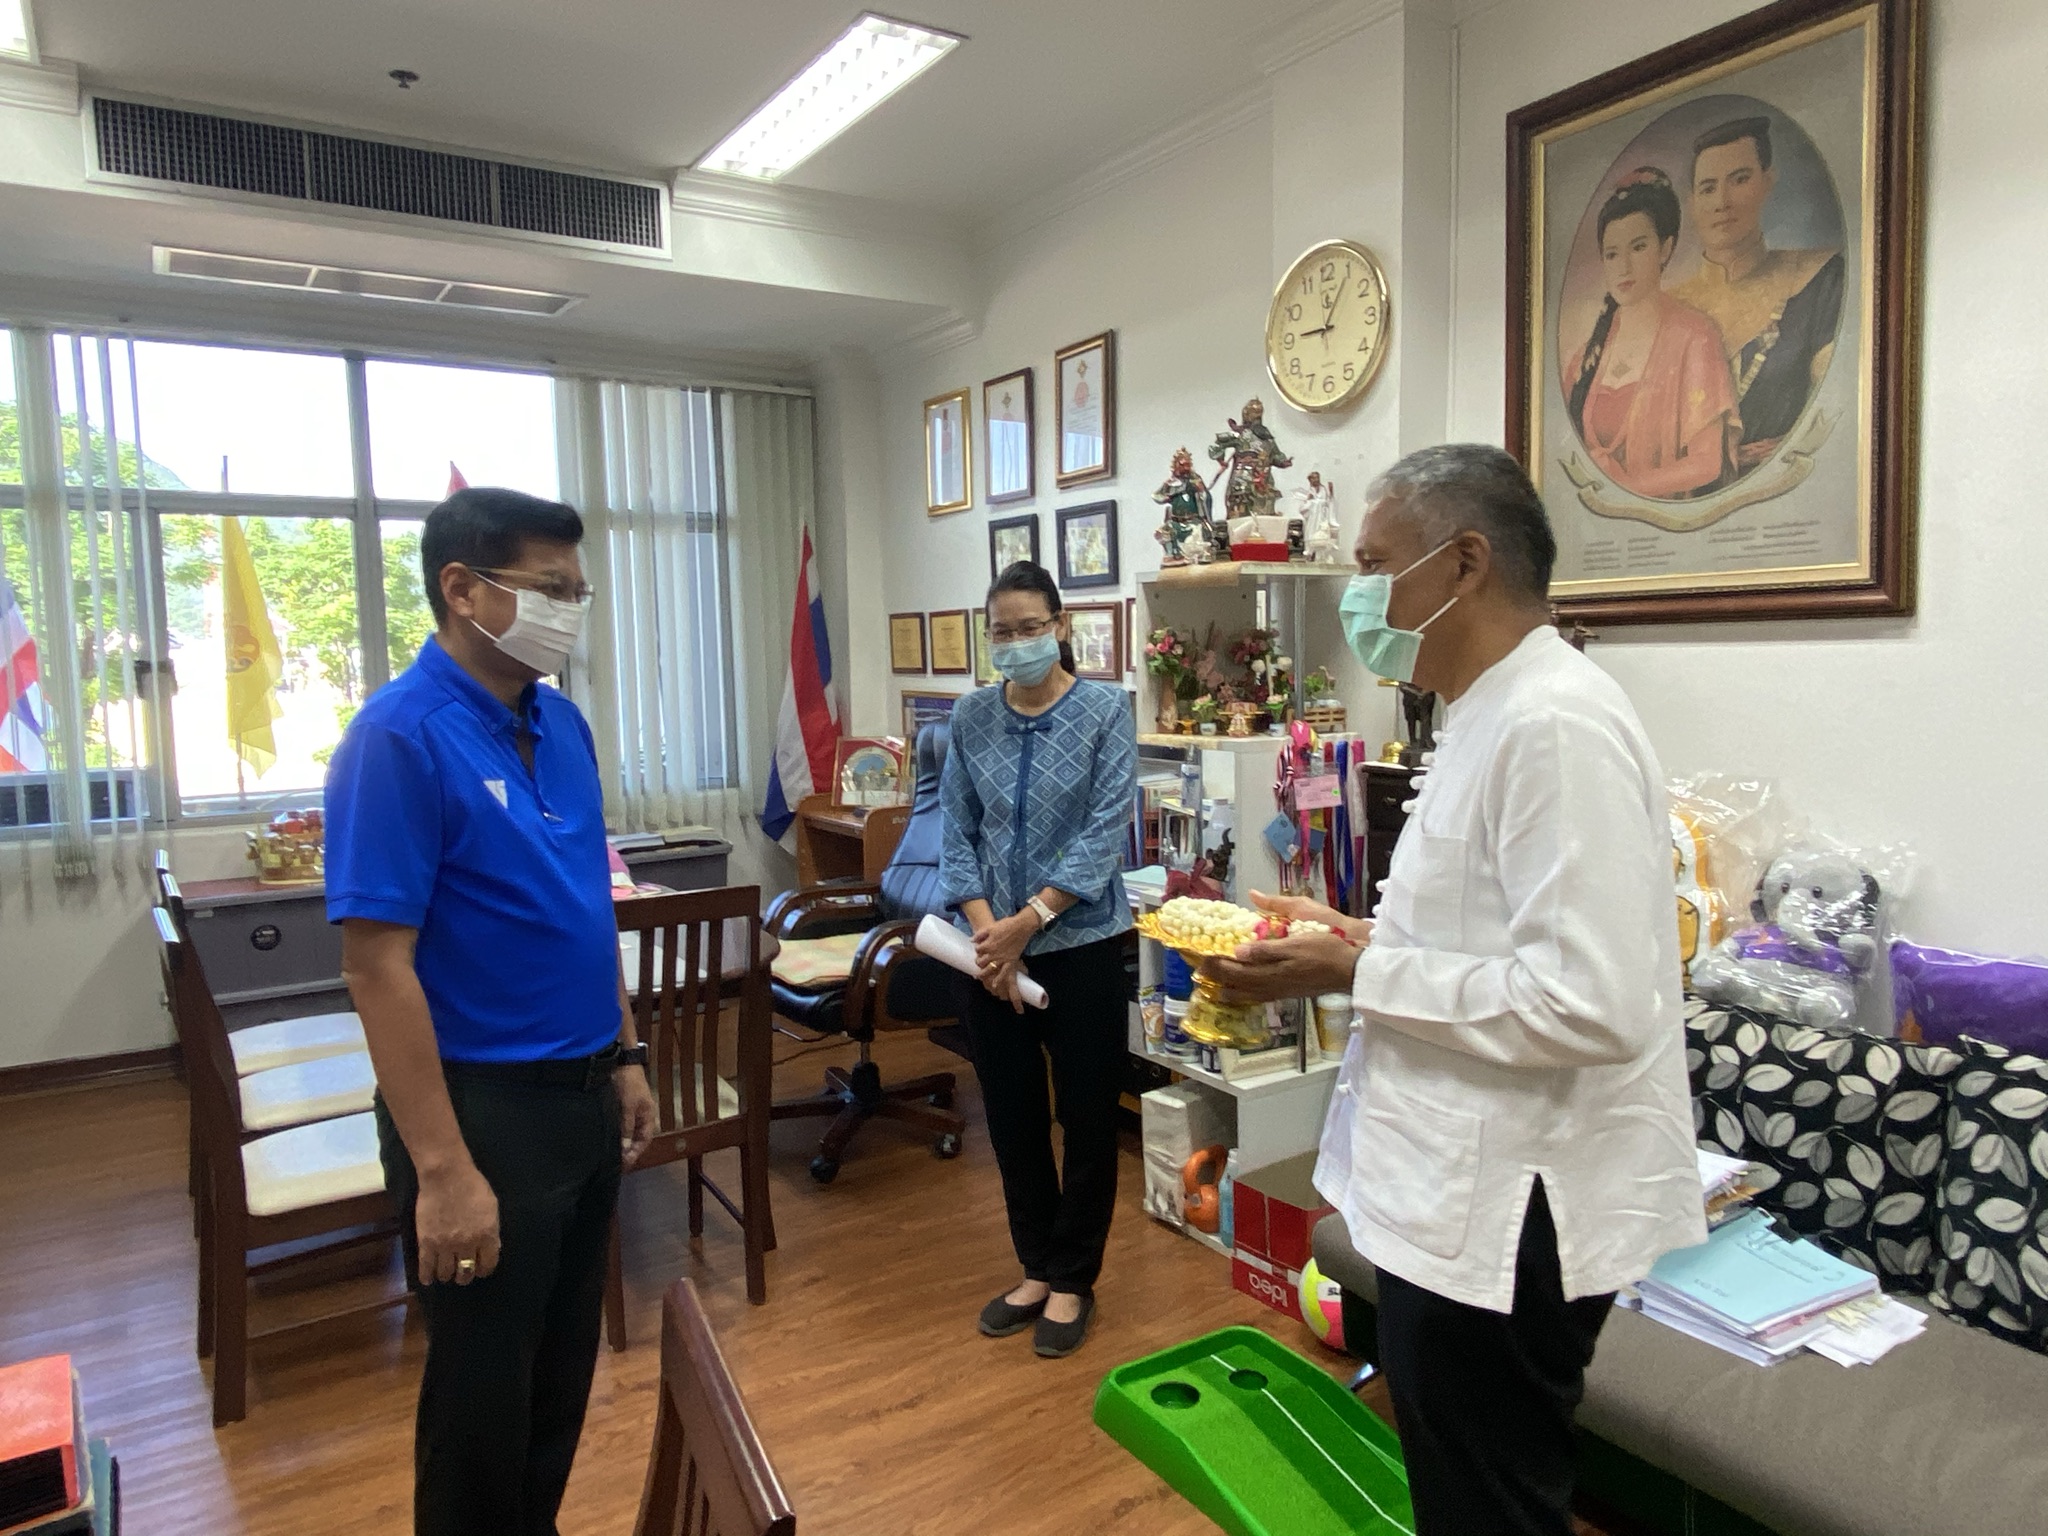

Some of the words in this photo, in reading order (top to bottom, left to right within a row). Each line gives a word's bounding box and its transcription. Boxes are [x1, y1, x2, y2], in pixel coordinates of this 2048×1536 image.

[1320, 262, 1335, 282] 12
[1345, 261, 1351, 279] 1
[1302, 276, 1313, 295] 11
[1357, 278, 1370, 298] 2
[1364, 306, 1376, 325] 3
[1283, 332, 1295, 350] 9
[1357, 336, 1370, 354] 4
[1289, 357, 1300, 375] 8
[1343, 362, 1354, 381] 5
[1305, 373, 1316, 391] 7
[1322, 375, 1335, 393] 6
